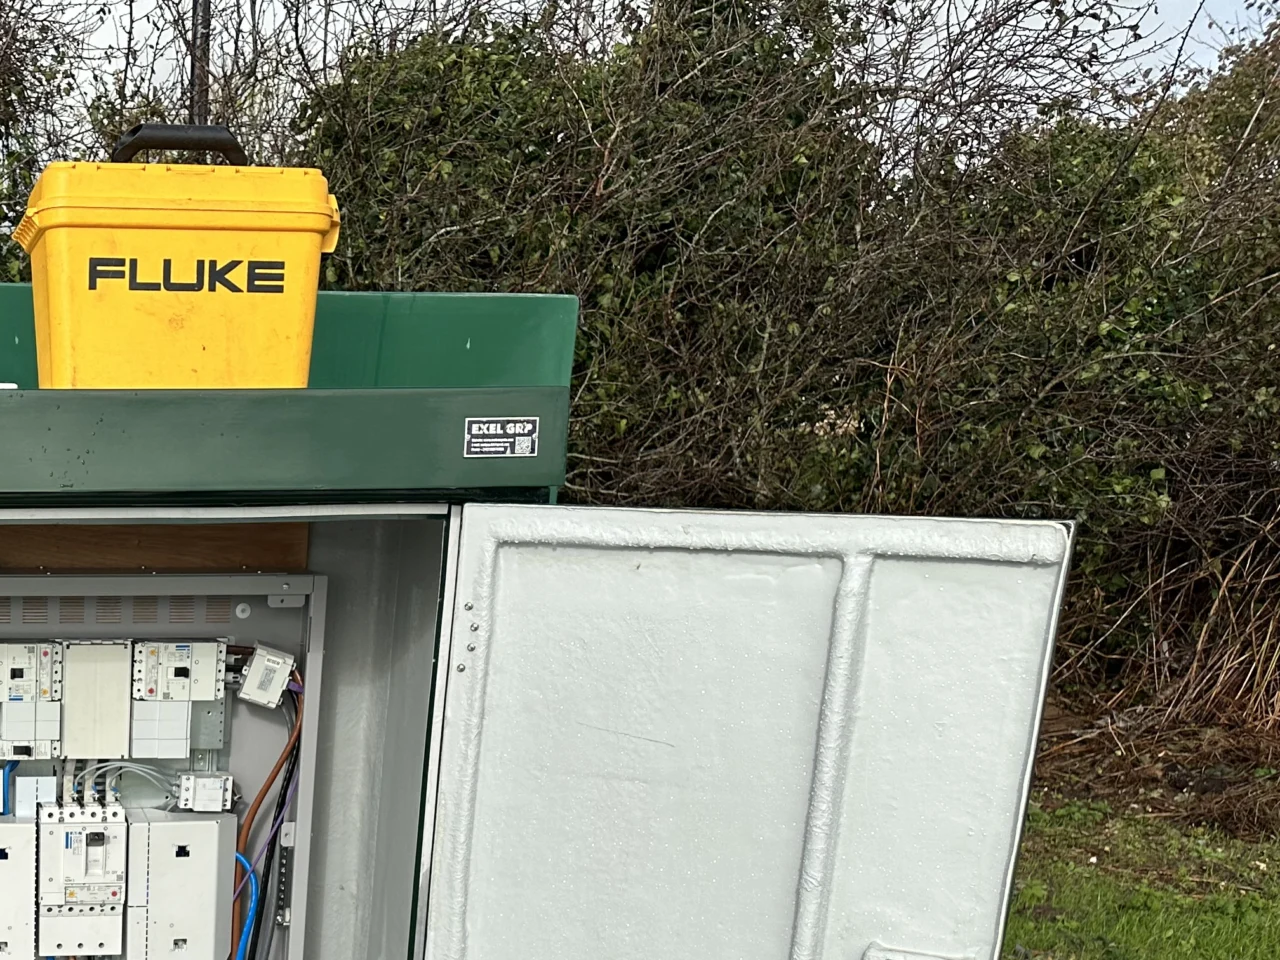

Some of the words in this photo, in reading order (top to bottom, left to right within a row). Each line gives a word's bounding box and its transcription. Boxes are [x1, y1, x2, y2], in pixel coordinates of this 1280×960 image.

[88, 257, 285, 294] FLUKE
[471, 423, 504, 434] EXEL
[506, 422, 533, 434] GRP
